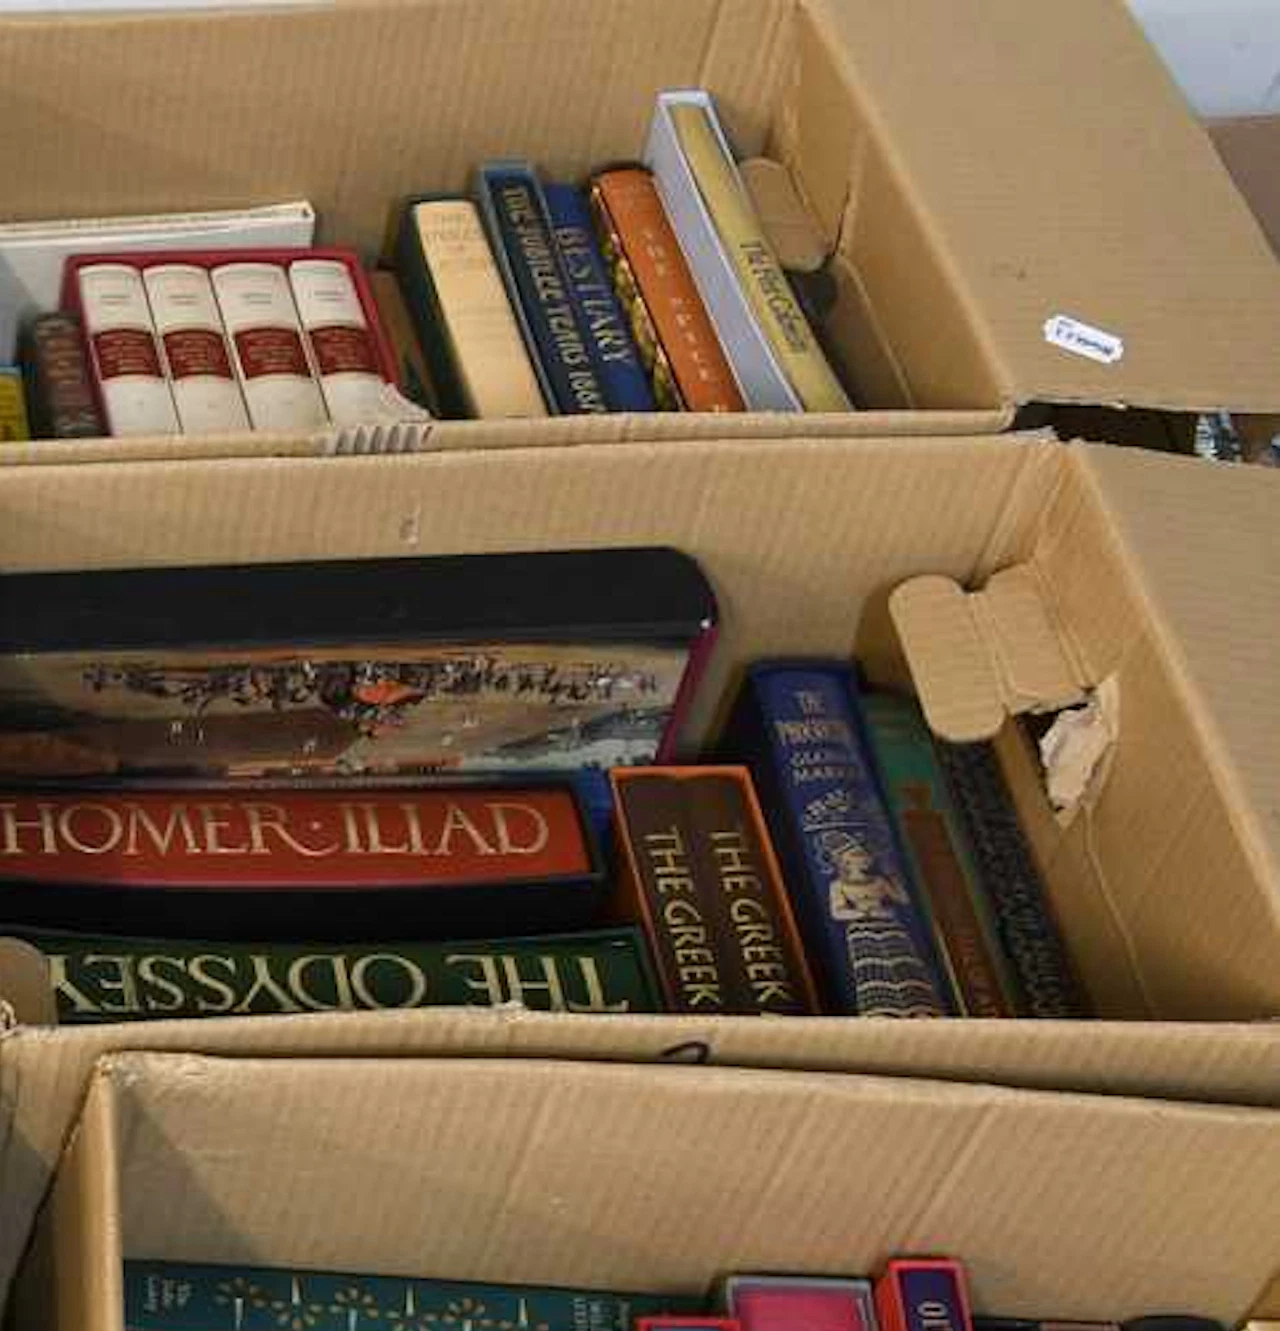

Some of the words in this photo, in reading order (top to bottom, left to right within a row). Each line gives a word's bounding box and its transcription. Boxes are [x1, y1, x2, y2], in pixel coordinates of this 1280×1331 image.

[554, 227, 633, 365] BESTIARY
[343, 800, 550, 854] ILIAD
[643, 825, 695, 894] THE
[710, 830, 755, 894] THE
[48, 952, 428, 1014] ODYSSEY
[445, 953, 630, 1014] THE
[662, 897, 722, 1006] GREEK
[729, 897, 788, 1012] GREEK
